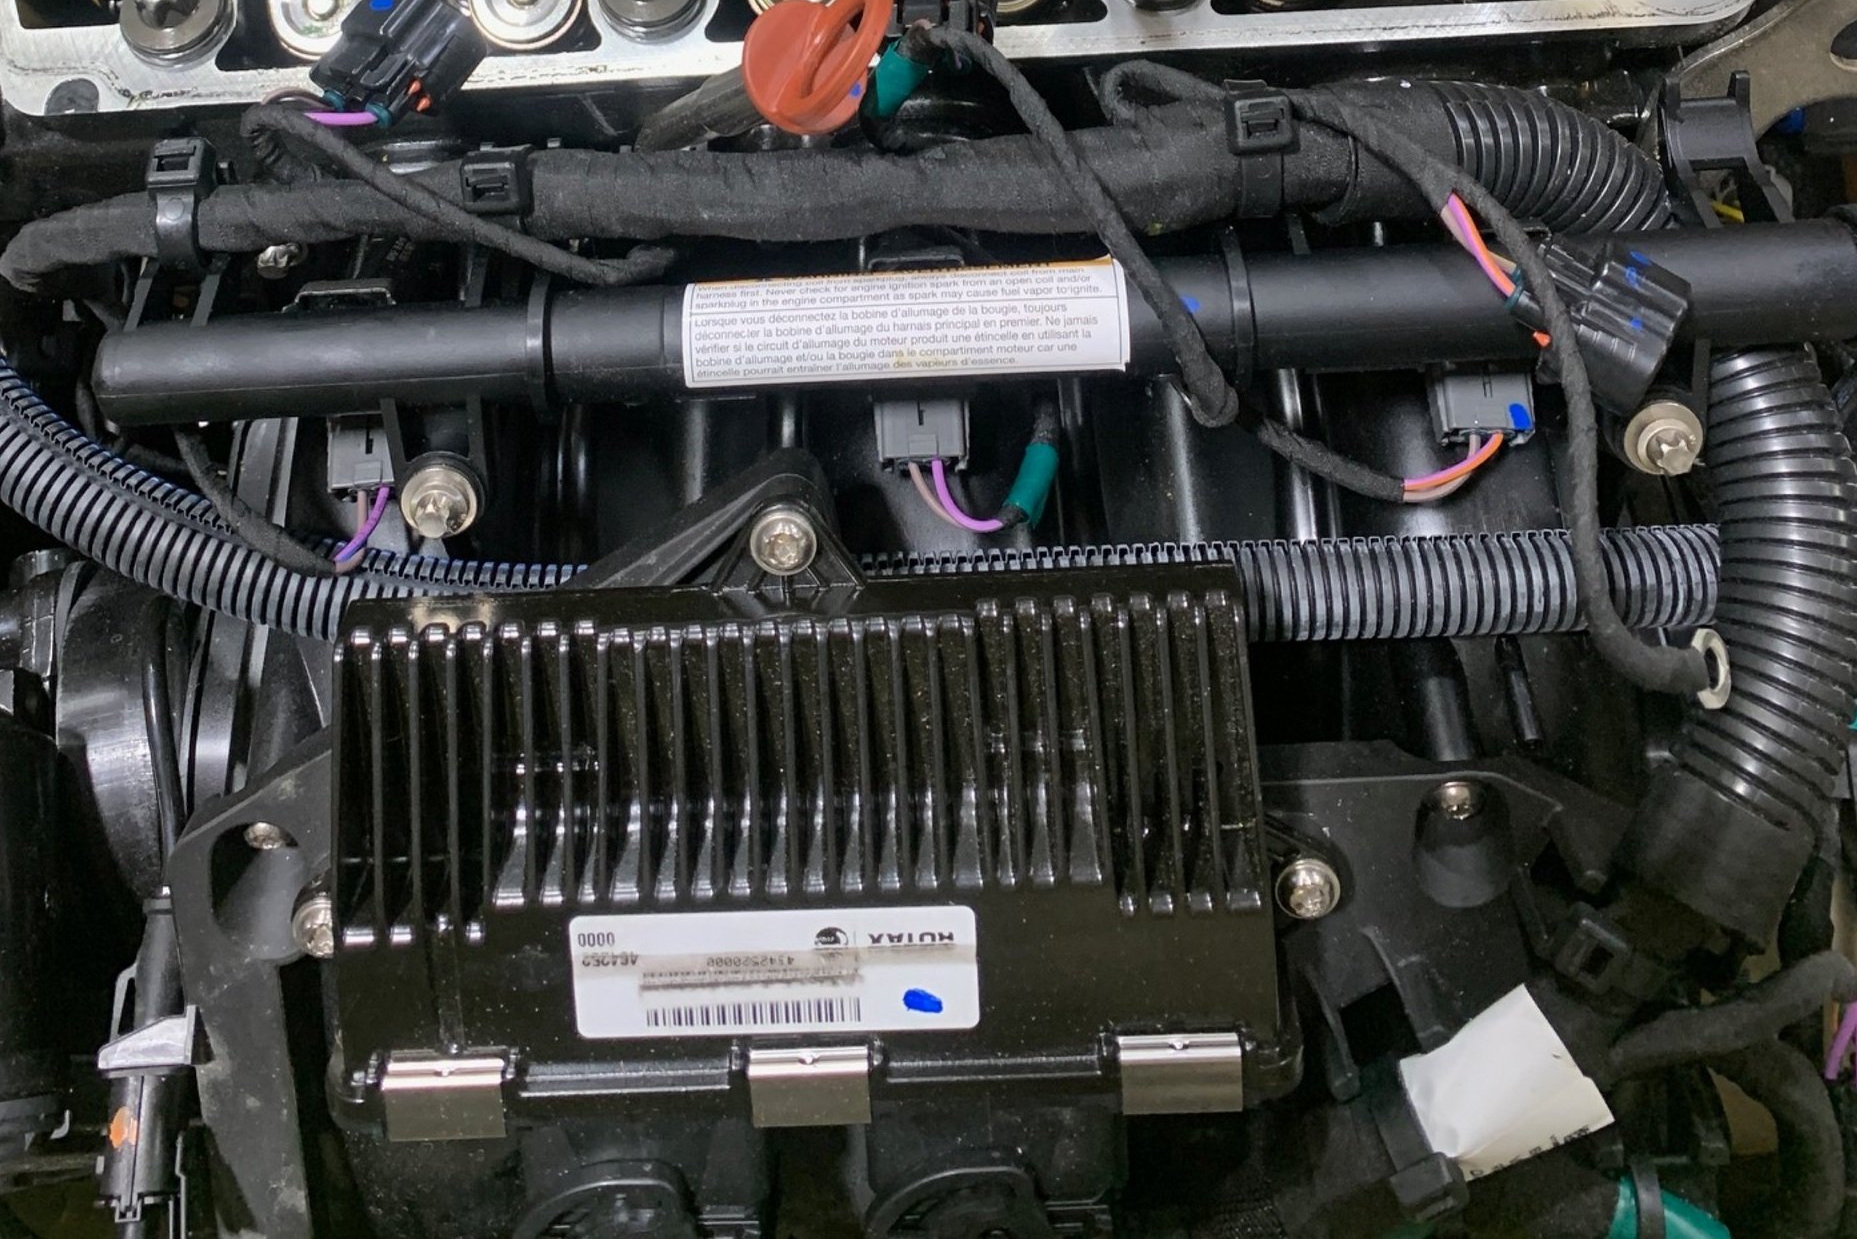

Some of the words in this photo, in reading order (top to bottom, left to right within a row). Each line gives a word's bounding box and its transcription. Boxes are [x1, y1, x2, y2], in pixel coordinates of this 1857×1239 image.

[799, 286, 831, 294] check
[850, 284, 886, 292] engine
[888, 282, 927, 290] ignition
[929, 280, 959, 288] spark
[695, 300, 746, 309] sparkplug
[781, 296, 817, 305] engine
[819, 292, 889, 303] compartment
[908, 290, 937, 299] spark
[694, 317, 737, 327] Lorsque
[740, 316, 765, 324] vous
[768, 311, 837, 323] déconnectez
[839, 311, 848, 319] la
[851, 309, 888, 319] bobine
[890, 307, 949, 317] d'allumage
[951, 305, 966, 314] de
[968, 305, 978, 314] la
[980, 303, 1020, 314] bougie,
[1023, 303, 1067, 313] toujours
[694, 329, 760, 340] déconnecter
[763, 328, 773, 337] la
[775, 326, 812, 337] bobine
[814, 324, 873, 335] d'allumage
[875, 322, 890, 332] du
[892, 320, 932, 331] harnais
[934, 318, 980, 331] principal
[999, 316, 1041, 329] premier.
[1045, 316, 1060, 325] Ne
[1062, 314, 1098, 327] jamais
[694, 344, 730, 354] vérifier
[732, 342, 742, 352] si
[744, 342, 754, 351] le
[756, 340, 789, 351] circuit
[791, 339, 850, 349] d'allumage
[852, 337, 867, 346] du
[869, 335, 908, 345] moteur
[910, 333, 948, 346] produit
[951, 334, 971, 342] une
[974, 330, 1018, 341] étincelle
[1037, 328, 1079, 339] utilisant
[1081, 328, 1091, 337] la
[695, 357, 732, 366] bobine
[734, 355, 793, 365] d'allumage
[795, 352, 823, 362] et/ou
[825, 351, 835, 360] la
[837, 350, 875, 360] bougie
[877, 349, 904, 358] dans
[906, 348, 917, 356] le
[918, 344, 993, 357] compartiment
[996, 343, 1034, 353] moteur
[1056, 343, 1077, 351] une
[696, 368, 739, 377] étincelle
[742, 365, 784, 377] pourrait
[786, 364, 832, 373] entraîner
[835, 362, 890, 371] l'allumage
[892, 360, 913, 368] des
[914, 359, 958, 368] vapeurs
[960, 357, 1017, 365] d'essence.
[577, 931, 615, 947] 0000
